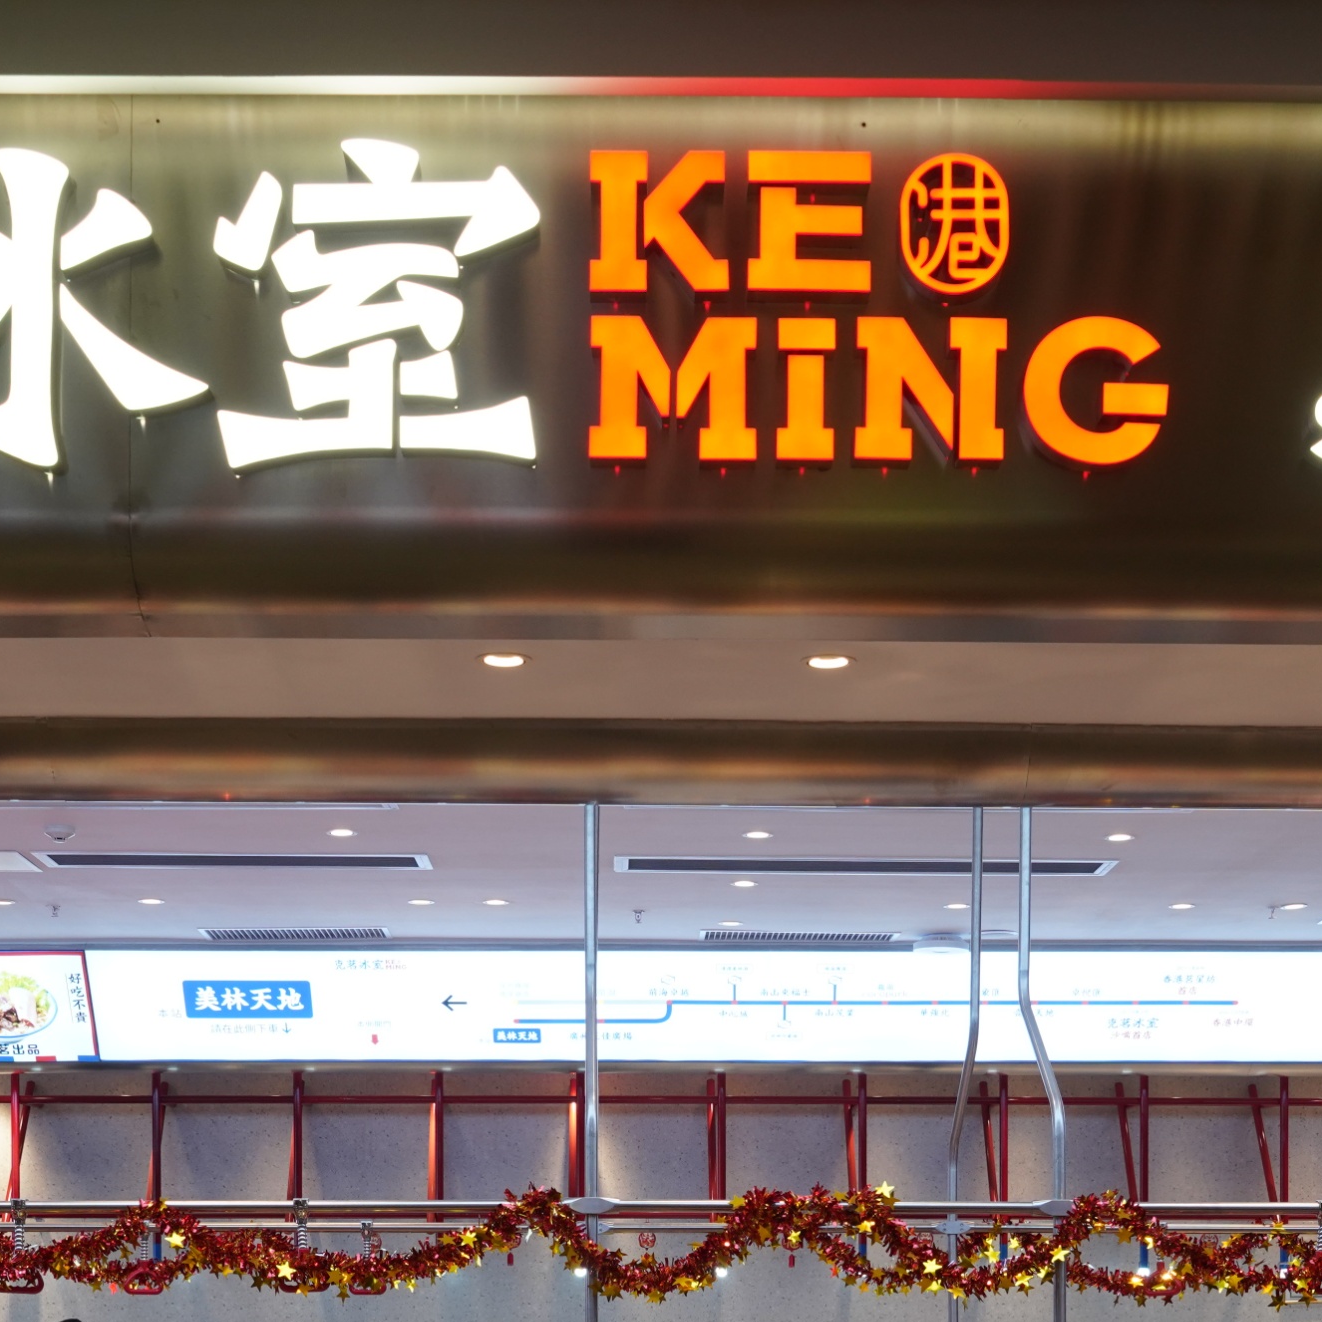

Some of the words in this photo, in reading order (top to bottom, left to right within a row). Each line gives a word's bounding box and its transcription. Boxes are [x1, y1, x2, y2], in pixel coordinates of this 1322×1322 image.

[589, 149, 872, 292] KE
[69, 972, 87, 1023] 好吃不貴
[194, 986, 307, 1012] 美林天地
